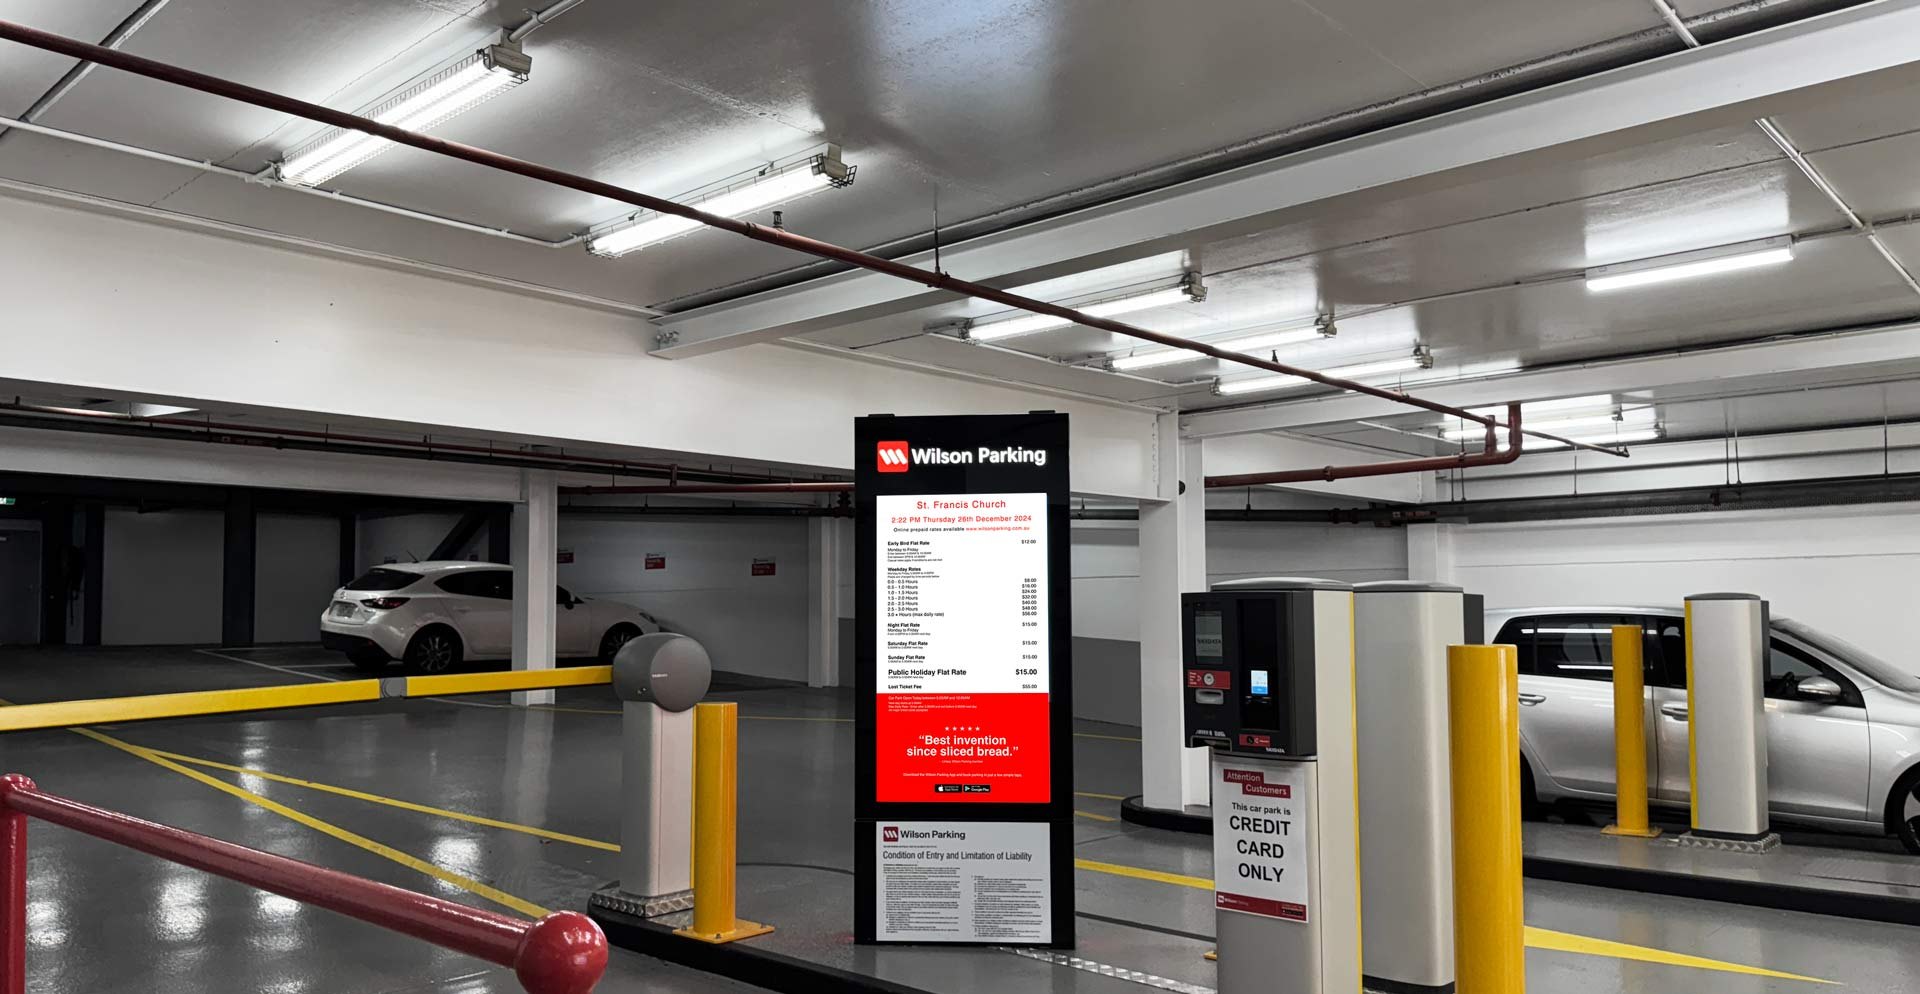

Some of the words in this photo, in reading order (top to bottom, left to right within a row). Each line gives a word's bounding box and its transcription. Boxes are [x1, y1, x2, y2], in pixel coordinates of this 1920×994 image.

[912, 447, 972, 465] Wilson
[978, 446, 1046, 466] Parking
[916, 501, 930, 510] St.
[933, 500, 968, 509] Francis
[971, 500, 1006, 508] Church
[923, 516, 956, 524] Thursday
[919, 735, 950, 745] “Best
[954, 735, 1006, 745] invention
[907, 746, 937, 756] since
[940, 746, 974, 756] sliced
[977, 746, 1019, 756] bread.”
[1227, 771, 1260, 782] Attention
[1245, 784, 1287, 795] Customers
[1232, 802, 1248, 811] This
[1264, 805, 1281, 815] park
[1284, 807, 1291, 815] is
[1230, 816, 1291, 836] CREDIT
[900, 830, 930, 839] Wilson
[932, 830, 966, 840] Parking
[1237, 839, 1284, 859] CARD
[883, 850, 916, 859] Condition
[918, 851, 925, 859] of
[926, 851, 944, 861] Entry
[946, 851, 959, 860] and
[961, 851, 995, 860] Limitation
[996, 851, 1004, 860] of
[1006, 852, 1032, 862] Liability
[1238, 863, 1284, 882] ONLY
